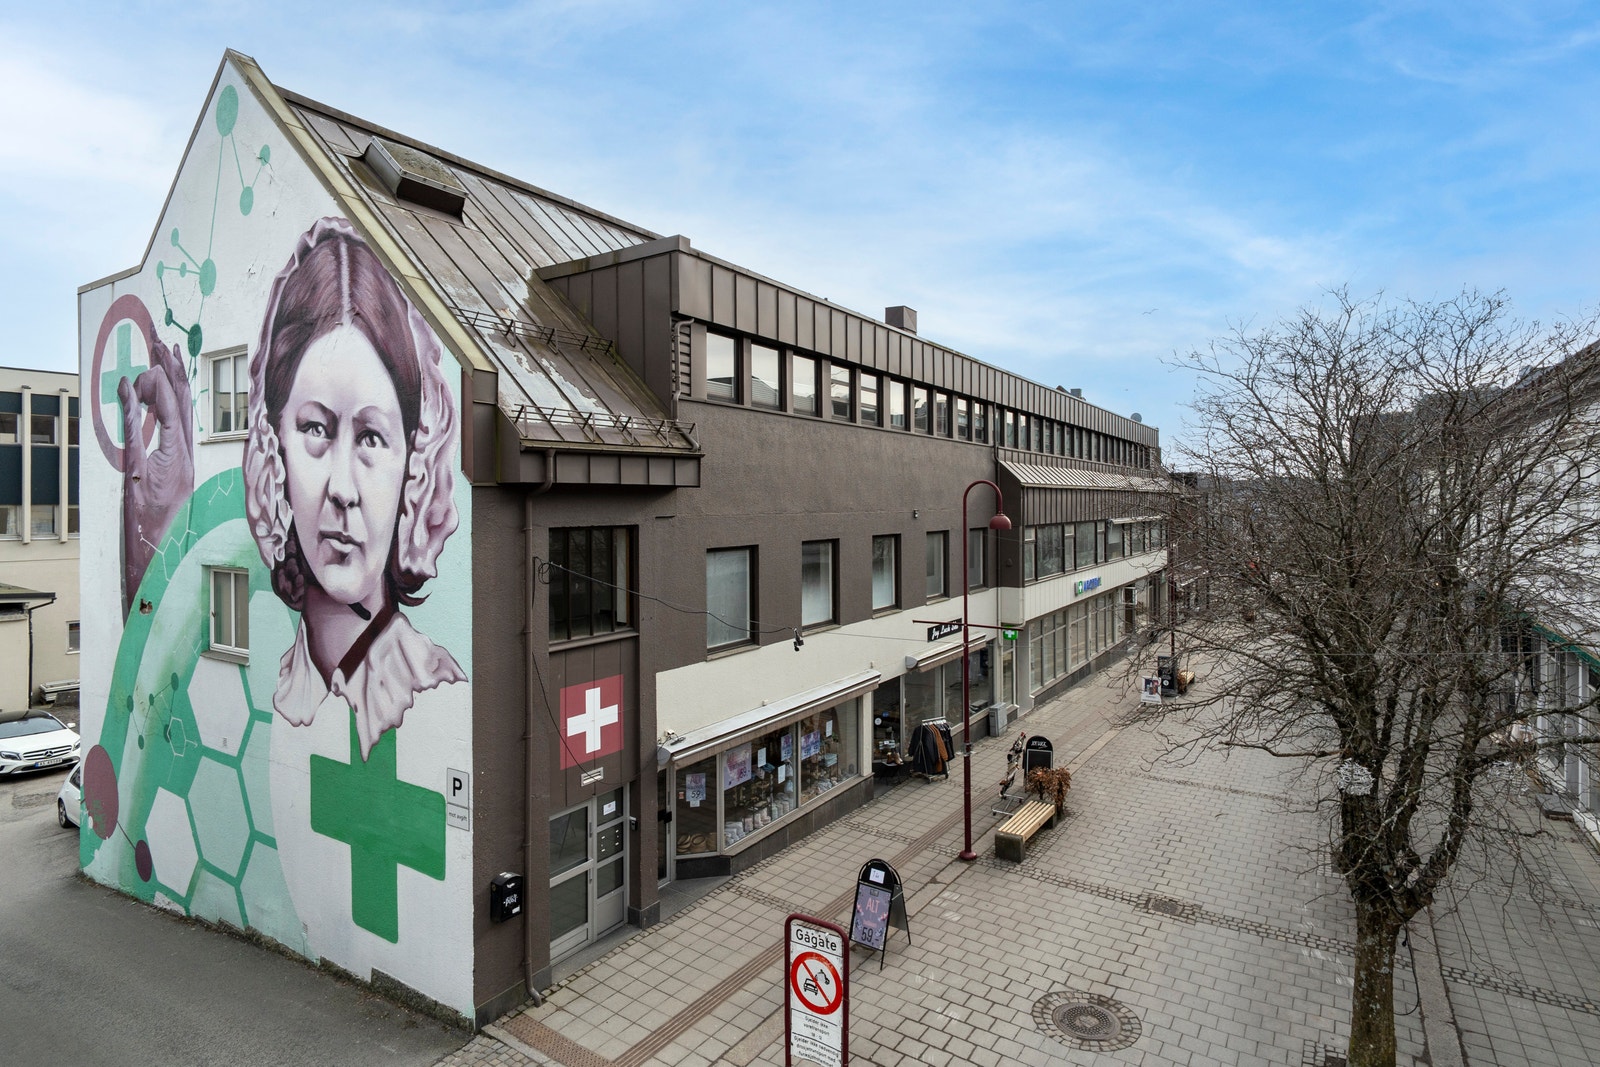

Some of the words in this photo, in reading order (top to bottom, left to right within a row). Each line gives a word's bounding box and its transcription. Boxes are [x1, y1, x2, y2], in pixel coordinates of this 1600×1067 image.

[453, 776, 463, 797] P
[866, 897, 880, 913] ALT
[795, 929, 837, 951] Gågate
